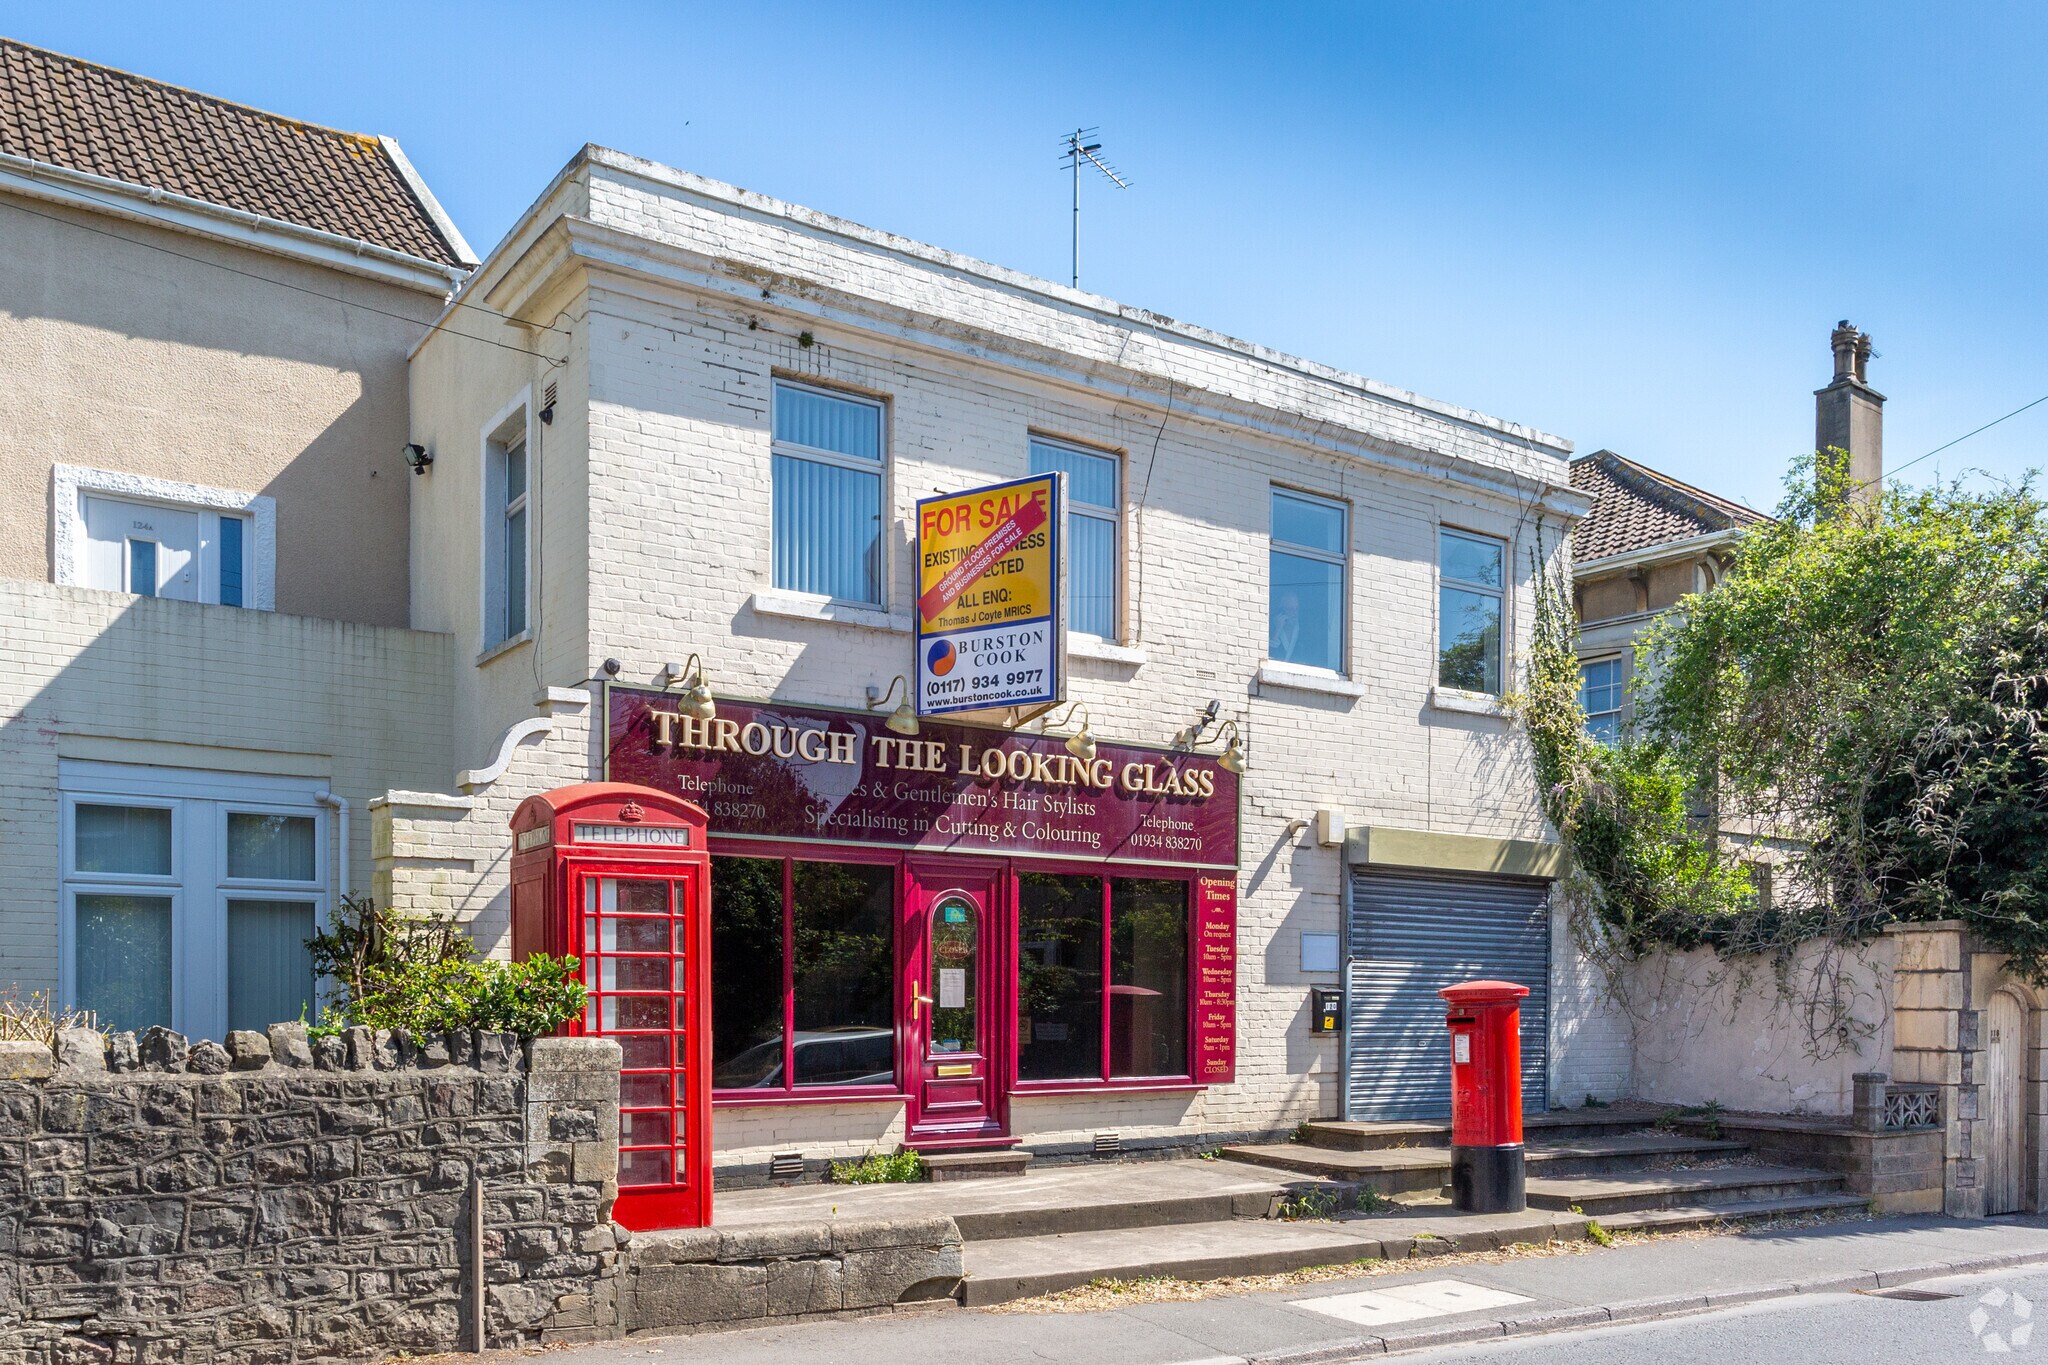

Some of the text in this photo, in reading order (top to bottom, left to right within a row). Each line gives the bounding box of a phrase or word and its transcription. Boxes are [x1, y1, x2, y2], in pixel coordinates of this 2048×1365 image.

[923, 504, 972, 540] FOR
[939, 520, 1017, 592] GROUND FLOOR PREMISES
[942, 527, 1023, 602] AND BUSINESSES FOR SALE
[957, 588, 1012, 609] ALL ENQ:
[938, 604, 1032, 627] Thomas J Coyte MRICS
[958, 630, 1043, 654] BURSTON
[974, 648, 1027, 667] COOK
[927, 669, 1043, 696] (0117) 934 9977
[927, 686, 1043, 707] www.burstoncook.co.uk
[651, 710, 1215, 798] THROUGH THE LOOKING GLASS
[677, 775, 754, 796] Telephone
[872, 781, 888, 799] &
[894, 782, 998, 808] Gentlemen's
[1003, 791, 1039, 811] Hair
[1043, 795, 1096, 818] Stylists
[714, 801, 766, 819] 838270
[804, 804, 1101, 849] Specialising in Cutting & Colouring
[1140, 813, 1194, 833] Telephone
[579, 825, 685, 844] TELEPHONE
[1131, 834, 1202, 851] 01934 838270
[1200, 877, 1235, 889] Opening
[1205, 890, 1231, 900] Times
[1205, 922, 1230, 931] Monday
[1213, 931, 1231, 940] request
[1205, 944, 1230, 954] Tuesday
[1220, 953, 1232, 962] 5pm
[1202, 967, 1232, 976] Wednesday
[1220, 976, 1232, 984] 5pm
[1204, 990, 1230, 999] Thursday
[1216, 998, 1235, 1007] 8:30pm
[1326, 1002, 1337, 1010] 120
[1208, 1013, 1226, 1022] Friday
[1220, 1021, 1232, 1030] 5pm
[1204, 1036, 1229, 1044] Saturday
[1219, 1044, 1230, 1052] 1pm
[1206, 1059, 1227, 1067] Sunday
